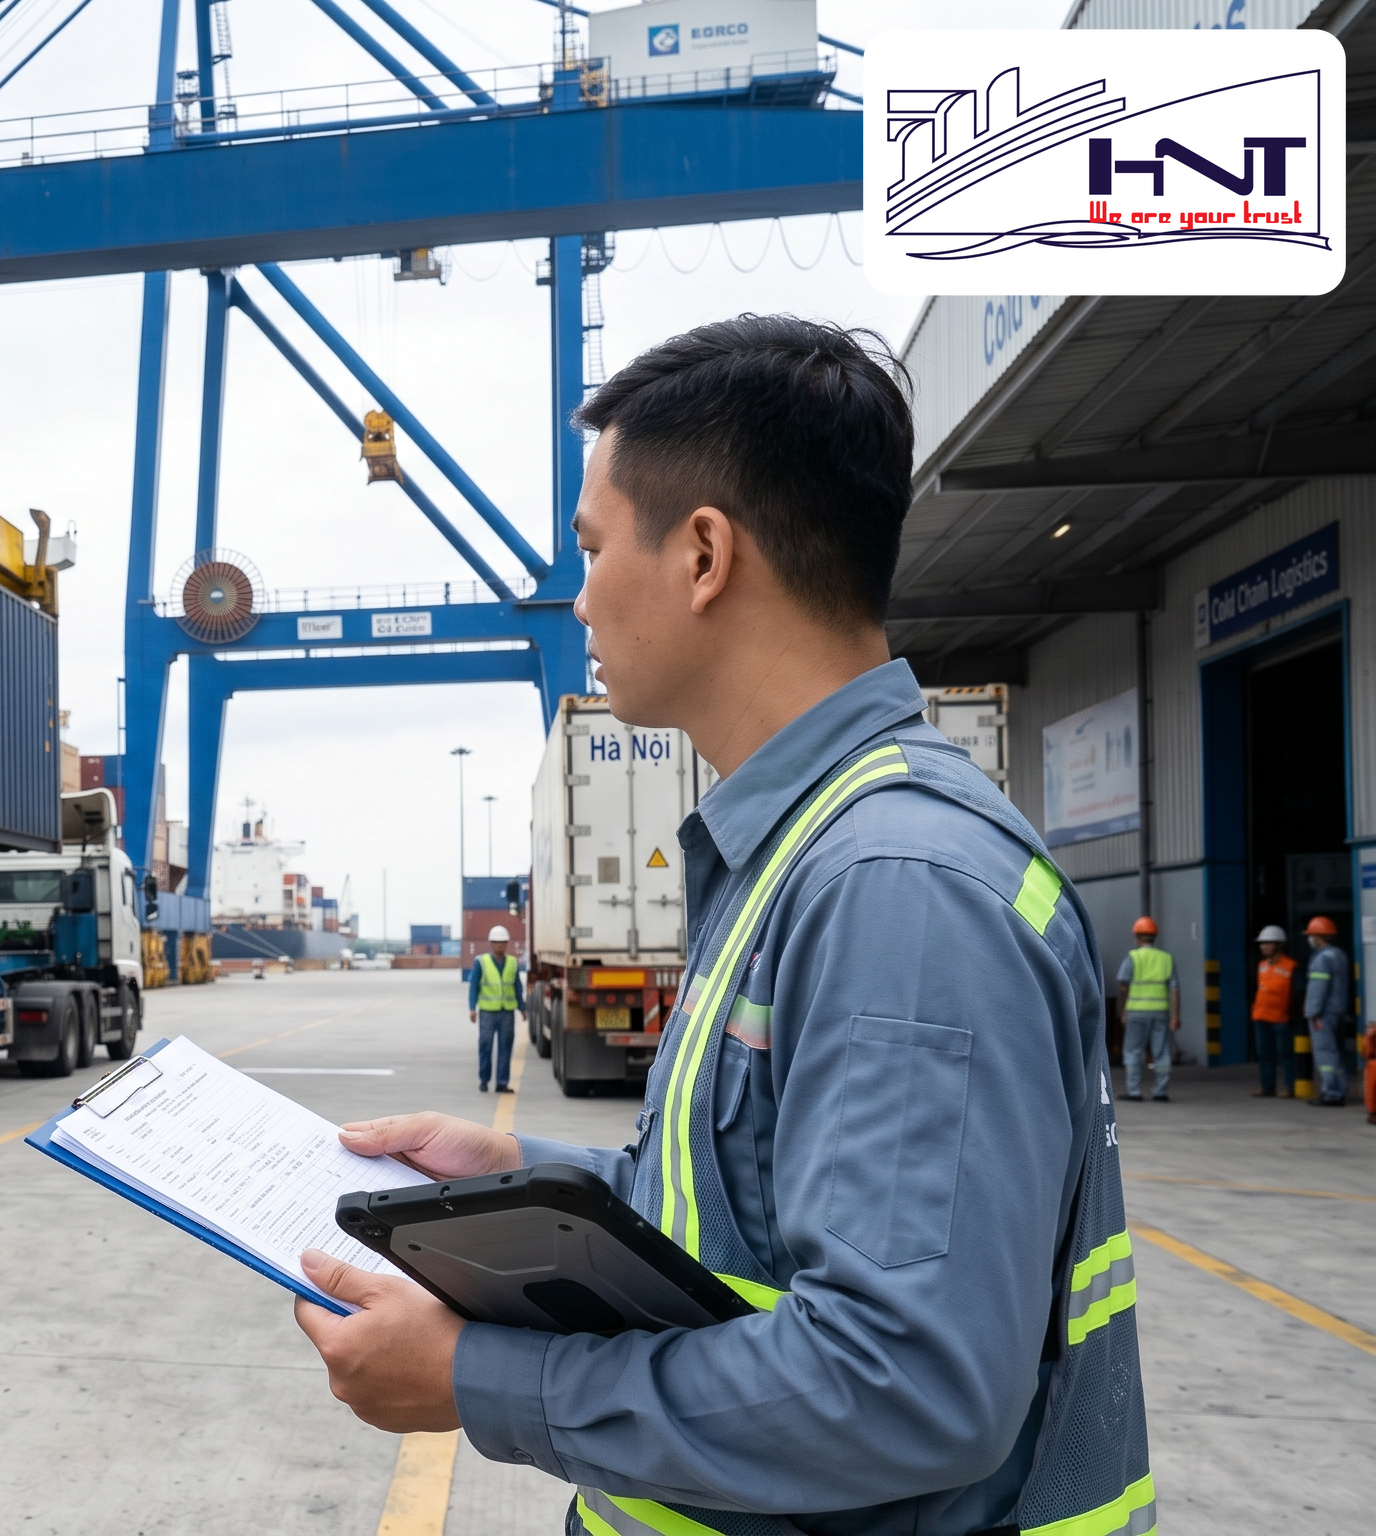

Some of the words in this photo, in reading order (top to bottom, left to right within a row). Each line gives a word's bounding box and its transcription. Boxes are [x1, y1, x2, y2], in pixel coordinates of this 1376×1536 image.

[1211, 587, 1236, 625] Cold
[1237, 574, 1269, 613] Chain
[1271, 549, 1328, 599] Logistics
[591, 733, 621, 761] Hà
[632, 733, 670, 766] Nội
